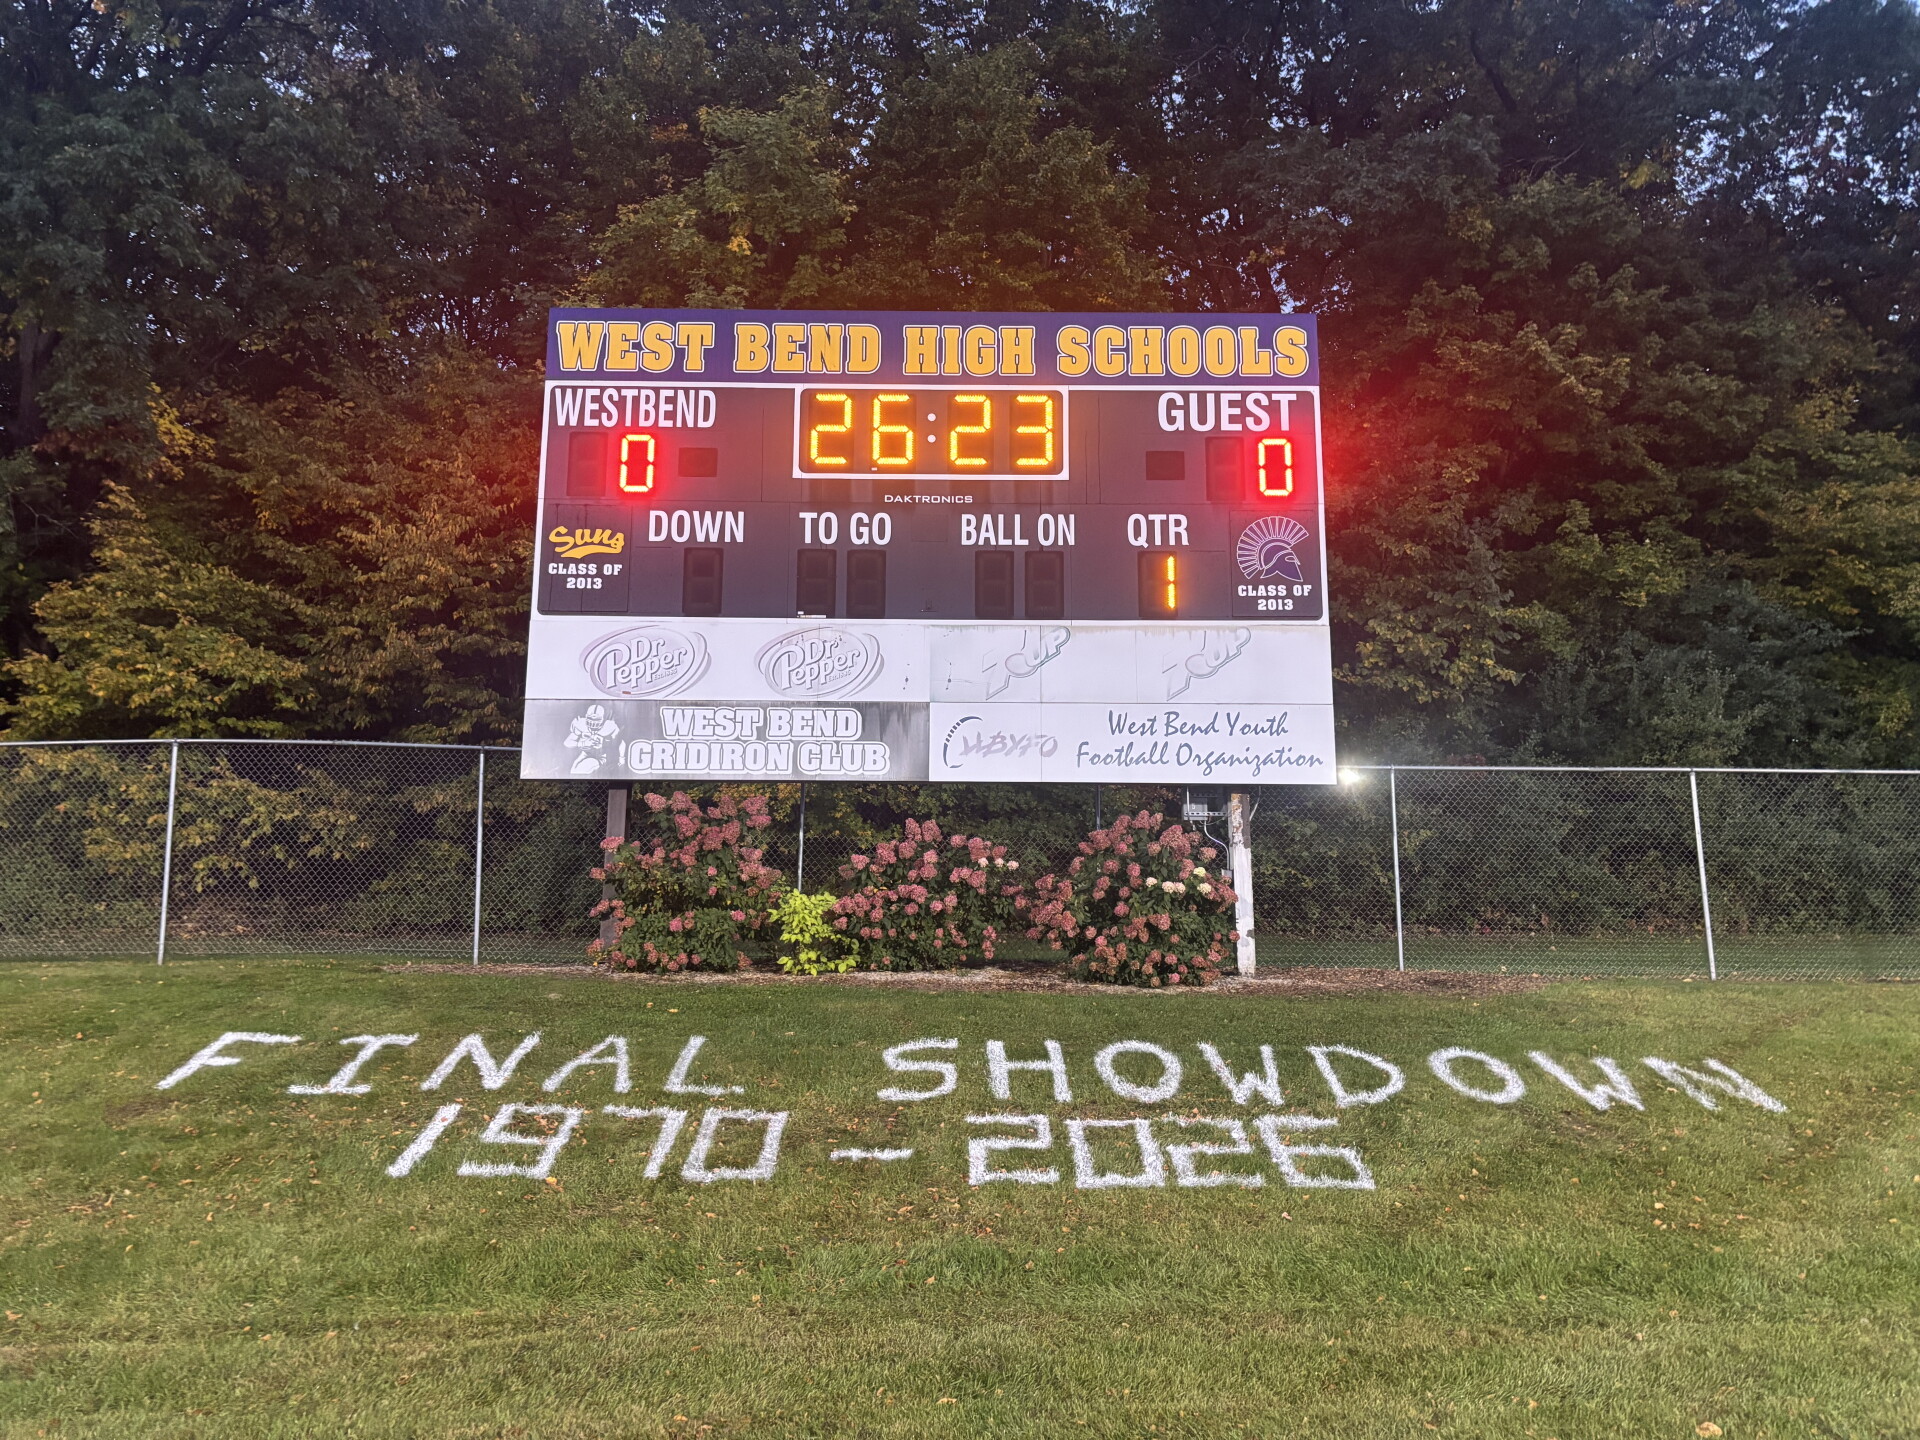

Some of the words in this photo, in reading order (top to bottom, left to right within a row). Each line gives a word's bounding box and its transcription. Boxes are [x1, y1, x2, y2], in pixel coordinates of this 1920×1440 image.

[556, 321, 715, 372] WEST
[733, 322, 882, 374] BEND
[902, 325, 1036, 376] HIGH
[1056, 325, 1309, 377] SCHOOLS
[554, 387, 717, 428] WESTBEND
[1158, 392, 1297, 431] GUEST
[620, 434, 655, 493] 0
[1258, 438, 1292, 496] 0
[884, 494, 973, 504] DAKTRONICS
[548, 525, 625, 553] Suns
[648, 510, 745, 543] DOWN
[799, 512, 838, 544] TO
[849, 512, 892, 545] GO
[961, 514, 1029, 546] BALL
[1037, 514, 1075, 546] ON
[1127, 514, 1189, 547] QTR
[548, 563, 597, 575] CLASS
[603, 564, 623, 575] OF
[566, 577, 603, 589] 2013
[1165, 555, 1176, 609] 1
[1237, 584, 1287, 596] CLASS
[1293, 584, 1312, 596] OF
[1257, 599, 1294, 610] 2013
[598, 642, 688, 689] Pepper
[630, 635, 666, 664] Dr
[803, 638, 839, 666] Dr
[771, 644, 860, 690] Pepper
[660, 707, 763, 740] WEST
[767, 707, 861, 740] BEND
[1108, 709, 1158, 736] West
[1163, 711, 1219, 737] Bend
[1226, 711, 1289, 736] Youth
[628, 740, 794, 774] GRIDIRON
[798, 741, 890, 774] CLUB
[1076, 741, 1170, 768] Football
[1175, 742, 1324, 777] Organization
[156, 1031, 745, 1095] FINAL
[876, 1036, 1789, 1115] SHOWDOWN
[385, 1103, 788, 1184] 1970
[964, 1111, 1376, 1191] 2026
